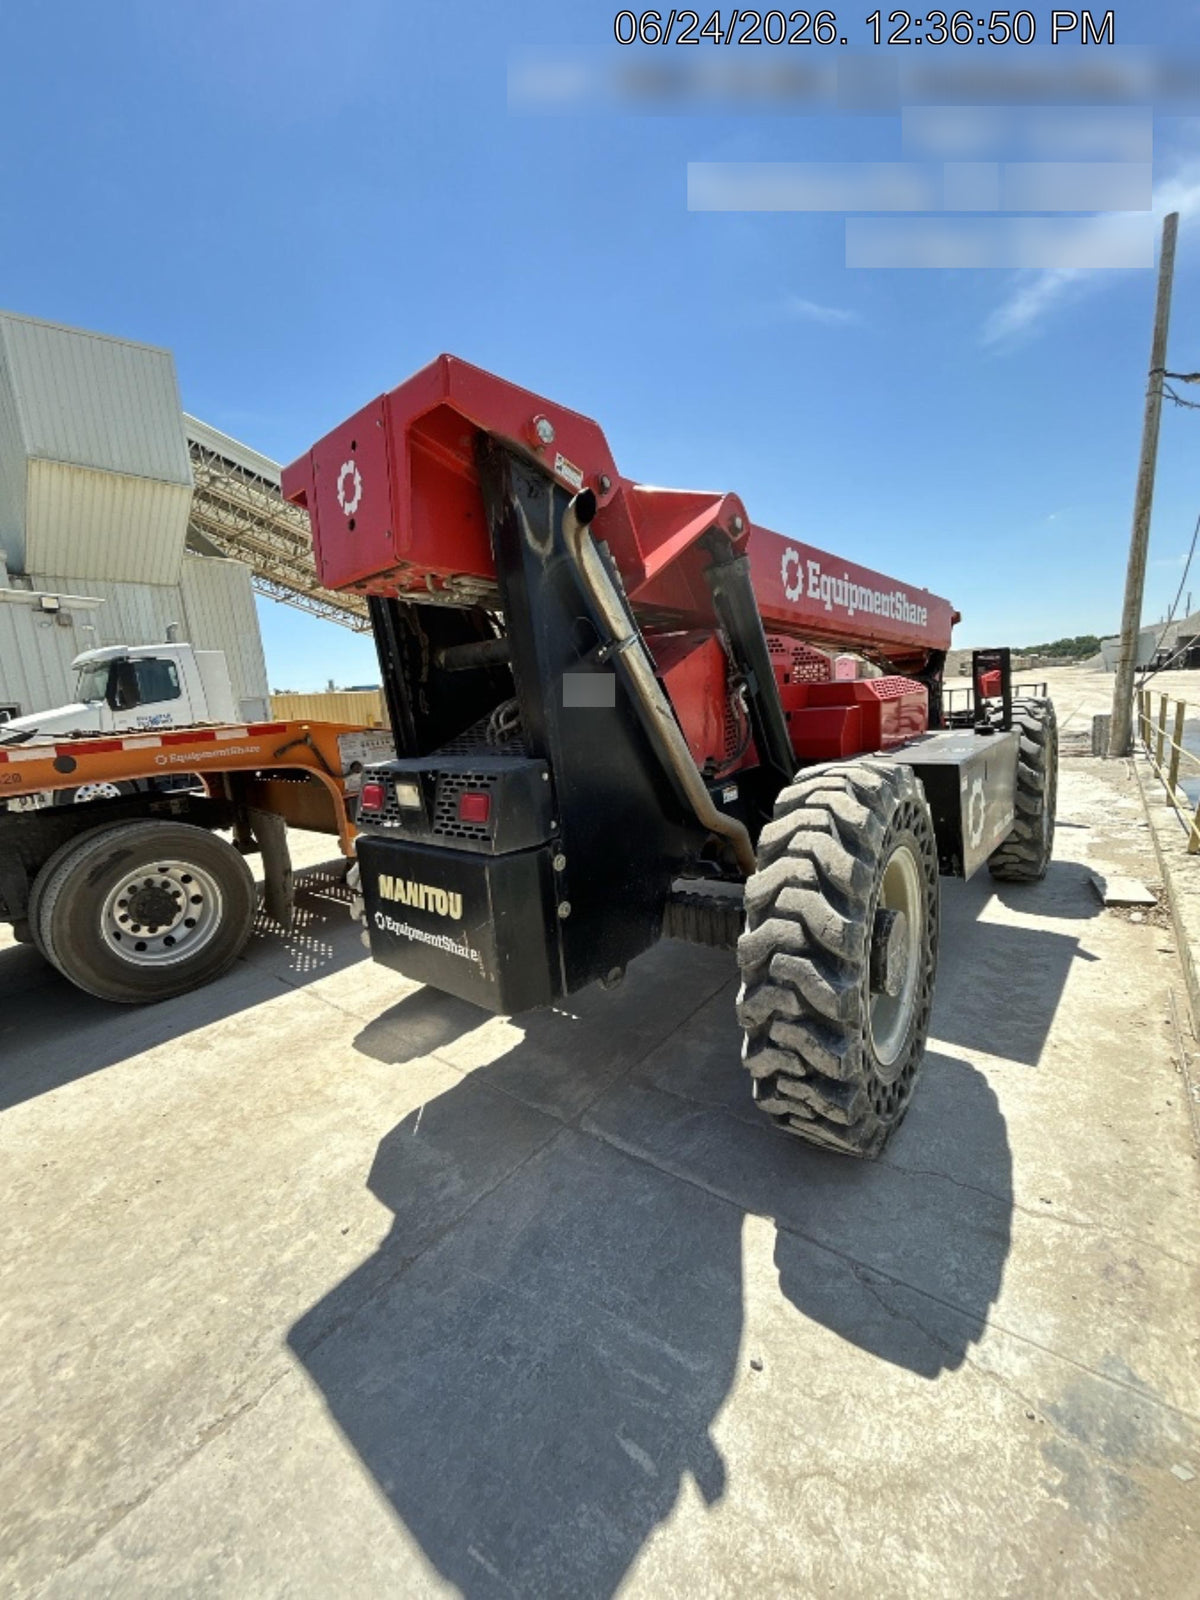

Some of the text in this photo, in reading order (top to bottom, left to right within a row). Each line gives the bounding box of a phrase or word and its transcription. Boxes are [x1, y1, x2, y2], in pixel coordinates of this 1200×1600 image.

[806, 559, 928, 627] EquipmentShare
[169, 745, 261, 764] EquipmentShare
[378, 873, 463, 920] MANITOU
[385, 915, 480, 961] EquipmentShare
